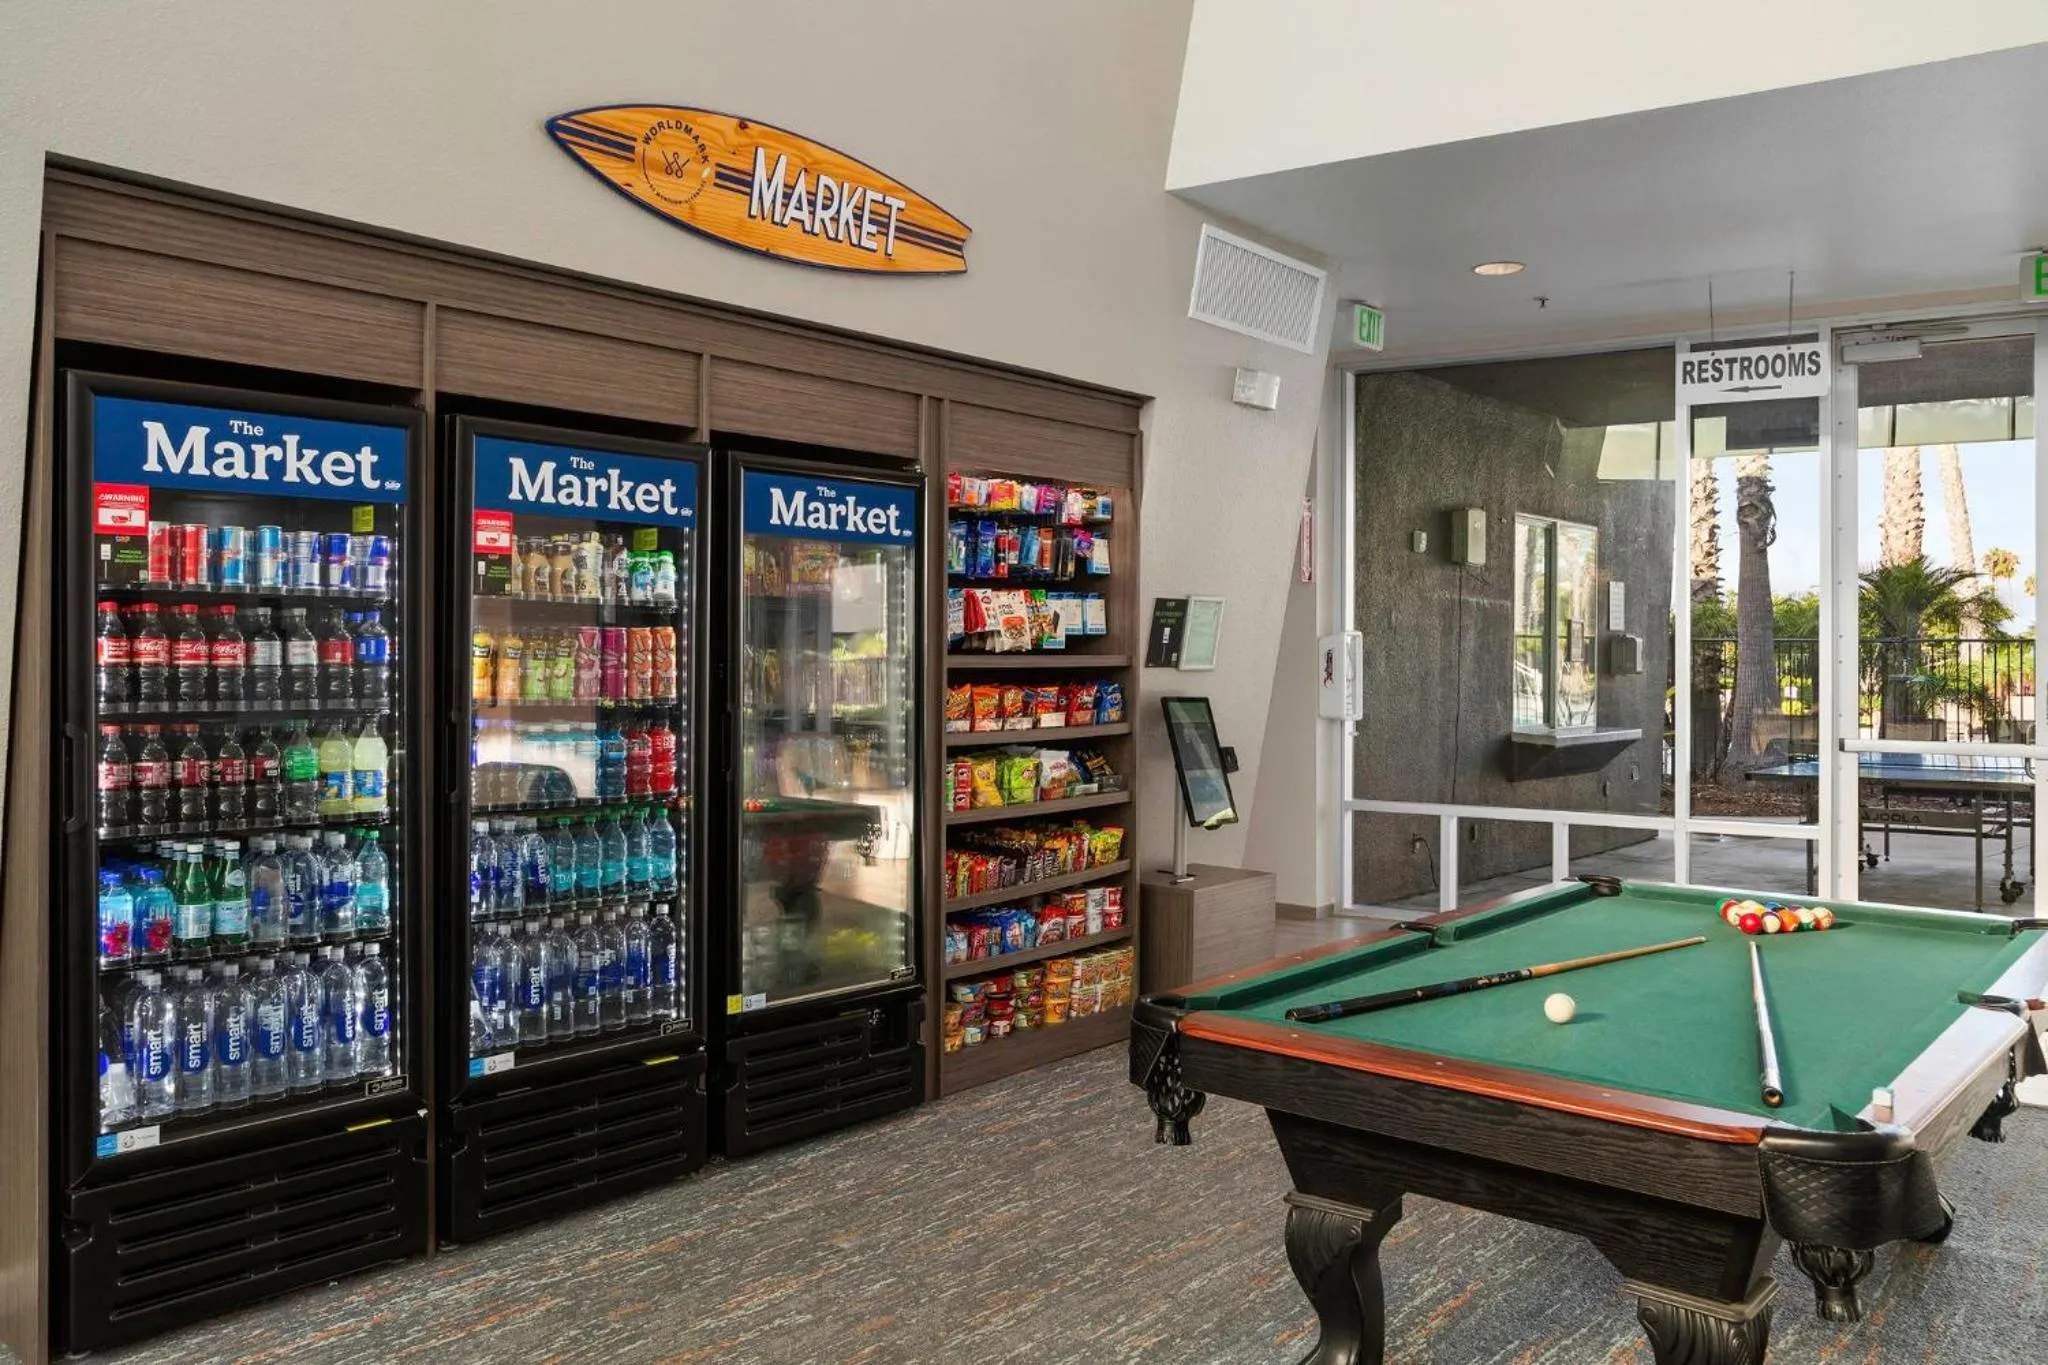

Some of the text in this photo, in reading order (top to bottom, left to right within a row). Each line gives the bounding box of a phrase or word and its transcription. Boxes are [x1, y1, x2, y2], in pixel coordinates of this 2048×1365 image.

[642, 119, 709, 164] WORLDMARK
[749, 146, 906, 255] MARKET
[1360, 308, 1381, 345] EXIT
[1681, 350, 1821, 385] RESTROOMS
[229, 419, 264, 437] The
[142, 421, 380, 489] Market
[570, 456, 595, 470] The
[104, 493, 145, 503] WARNING
[508, 457, 678, 516] Market
[816, 485, 836, 498] The
[769, 487, 900, 537] Market
[529, 966, 541, 1005] smart
[301, 1004, 313, 1048] smart
[373, 989, 384, 1031] smart
[147, 1028, 162, 1075] smart
[188, 1022, 201, 1069] smart
[227, 1015, 240, 1060] smart
